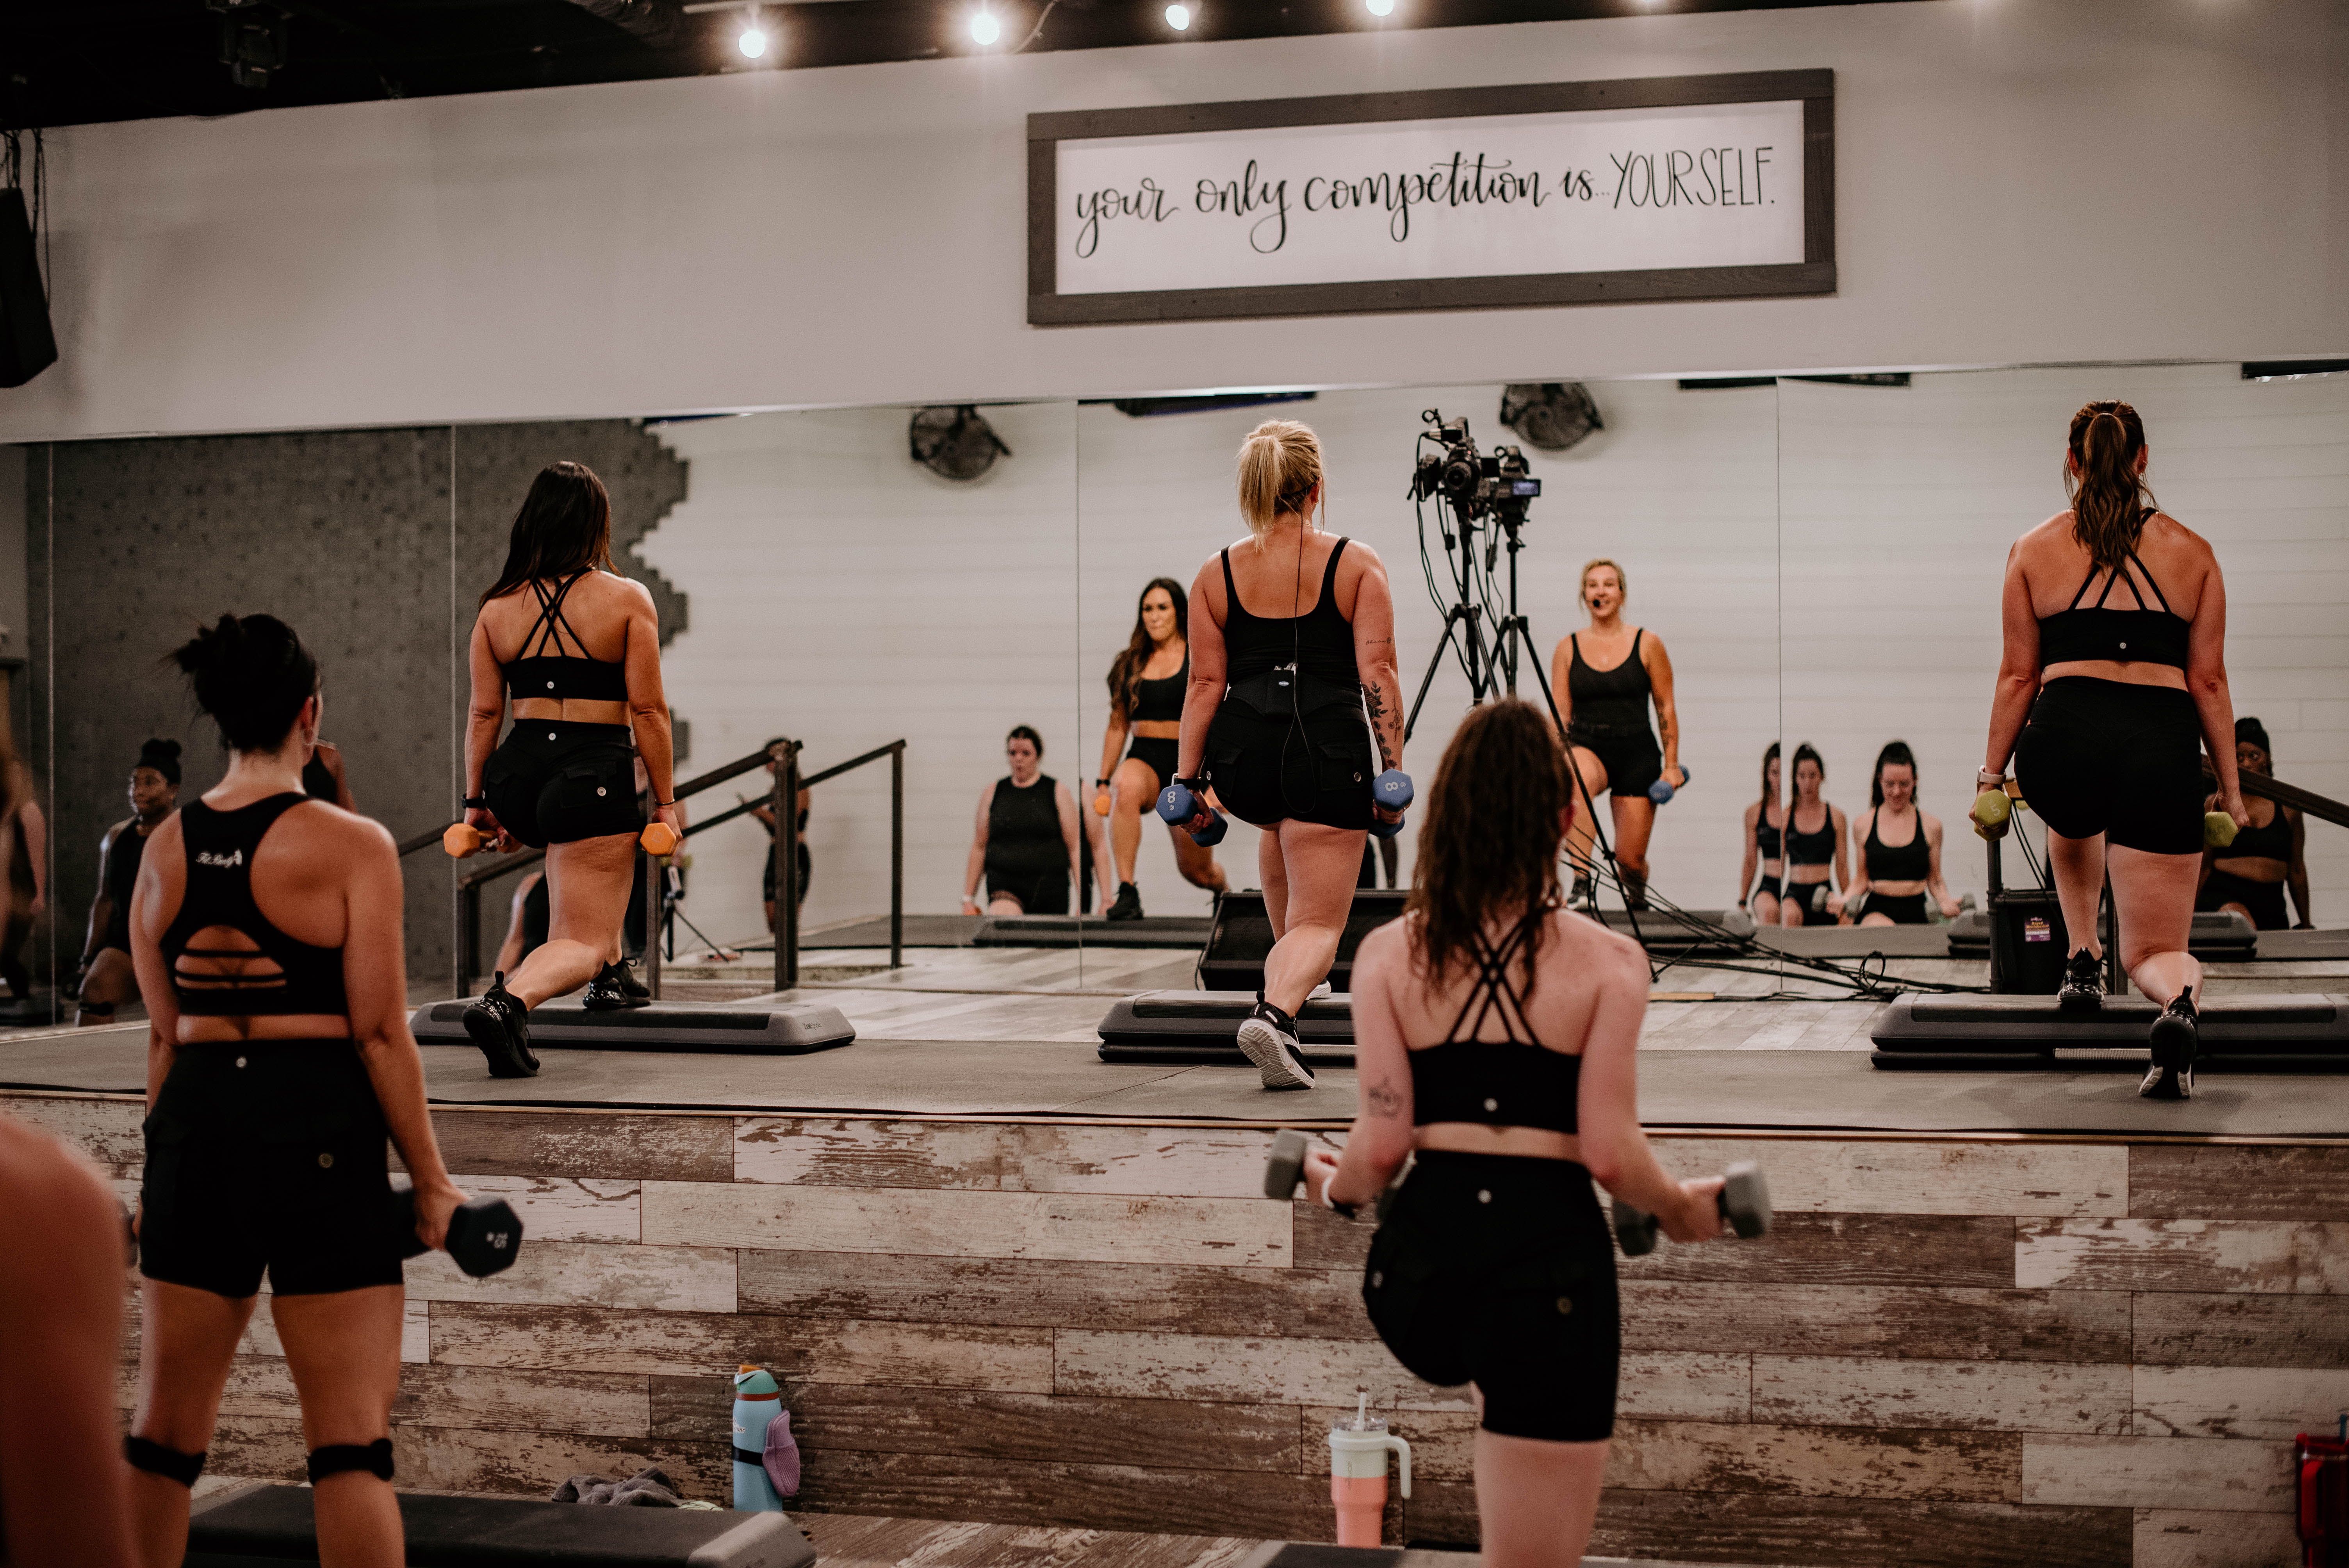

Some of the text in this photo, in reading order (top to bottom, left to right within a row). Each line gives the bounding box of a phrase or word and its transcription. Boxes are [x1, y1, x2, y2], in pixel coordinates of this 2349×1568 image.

[1076, 177, 1180, 258] your
[1196, 159, 1292, 253] only
[1304, 151, 1551, 242] competition
[1610, 147, 1774, 209] YOURSELF.
[1385, 782, 1398, 791] 8
[1167, 791, 1176, 804] 8
[1990, 804, 2001, 816] 5
